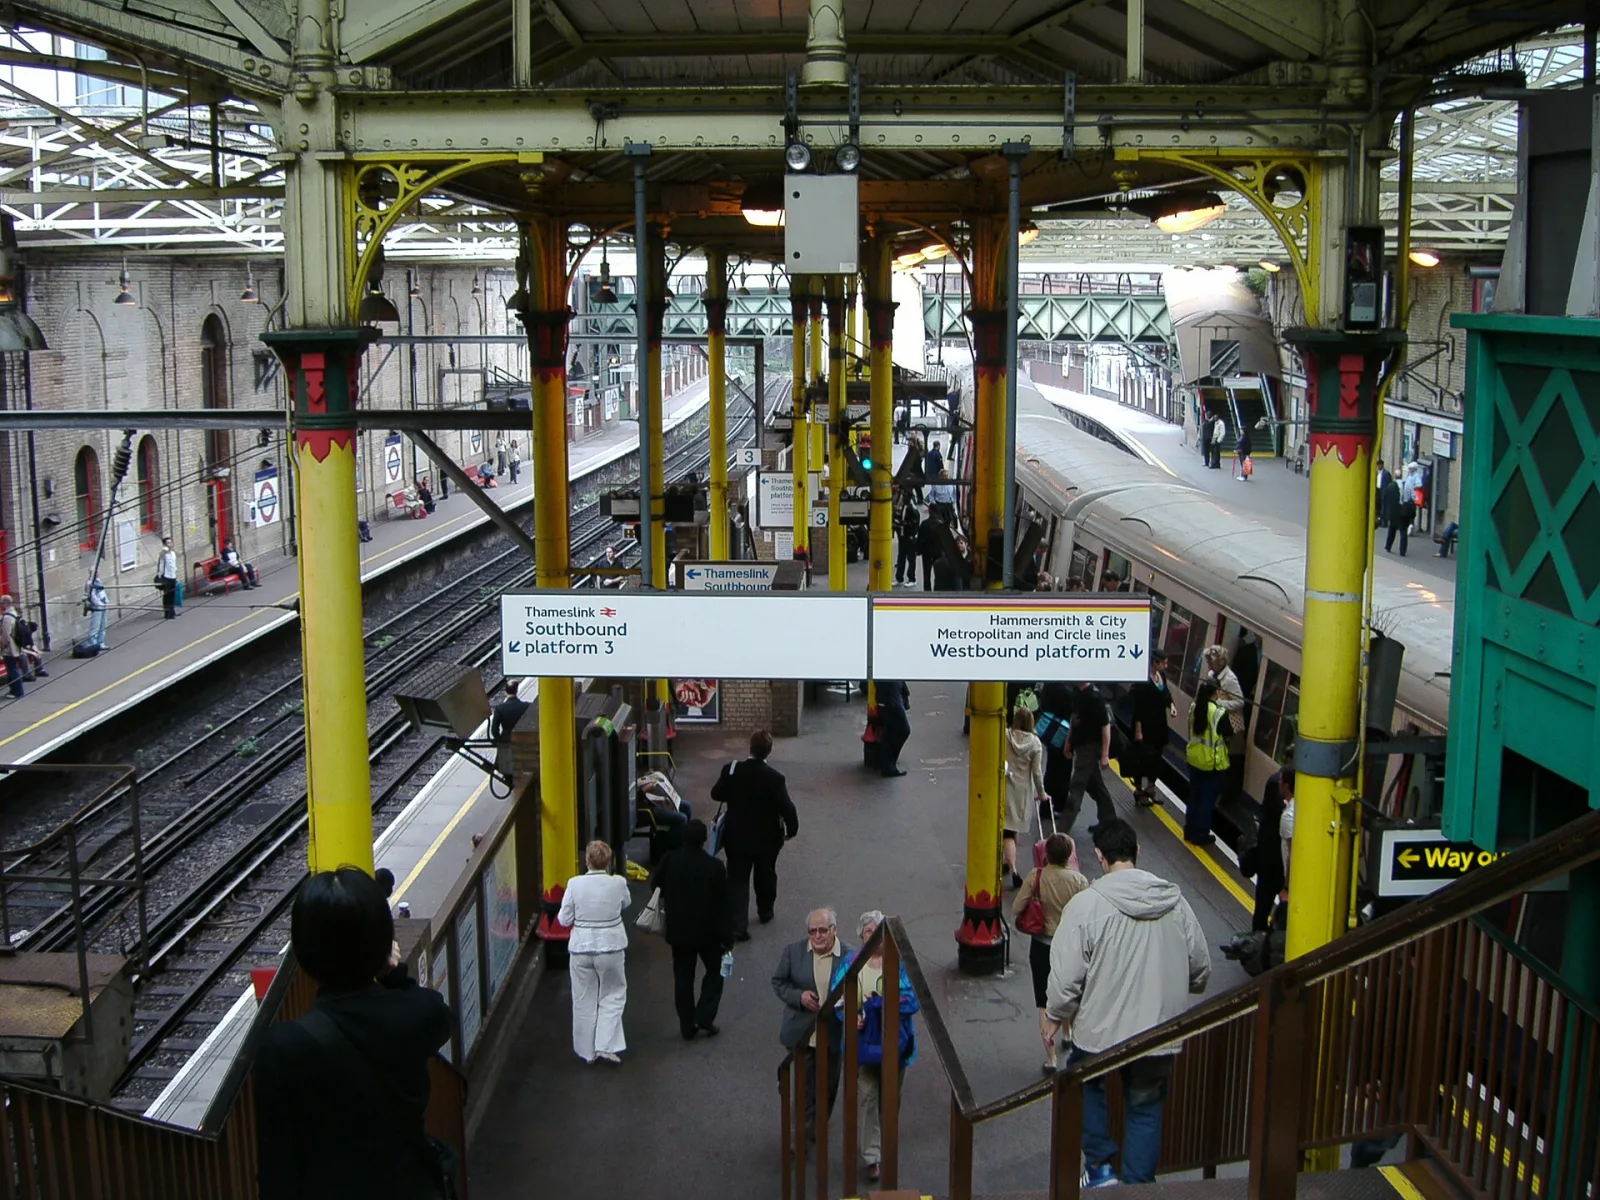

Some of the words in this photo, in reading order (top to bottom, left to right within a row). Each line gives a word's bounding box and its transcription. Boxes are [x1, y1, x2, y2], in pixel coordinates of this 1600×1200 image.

[744, 450, 754, 464] 3
[770, 477, 794, 485] Thames
[816, 512, 826, 525] 3
[704, 568, 770, 579] Thameslink
[525, 606, 596, 618] Thameslink
[990, 614, 1080, 626] Hammersmith
[1085, 615, 1094, 626] &
[1099, 615, 1127, 628] City
[525, 621, 627, 636] Southbound
[937, 628, 1022, 642] Metropolitan
[1026, 628, 1049, 640] and
[1054, 628, 1091, 640] Circle
[1096, 628, 1126, 640] lines
[525, 640, 598, 657] platform
[604, 640, 614, 655] 3
[930, 643, 1029, 658] Westbound
[1035, 644, 1110, 661] platform
[1117, 644, 1126, 659] 2
[1424, 847, 1474, 872] Way
